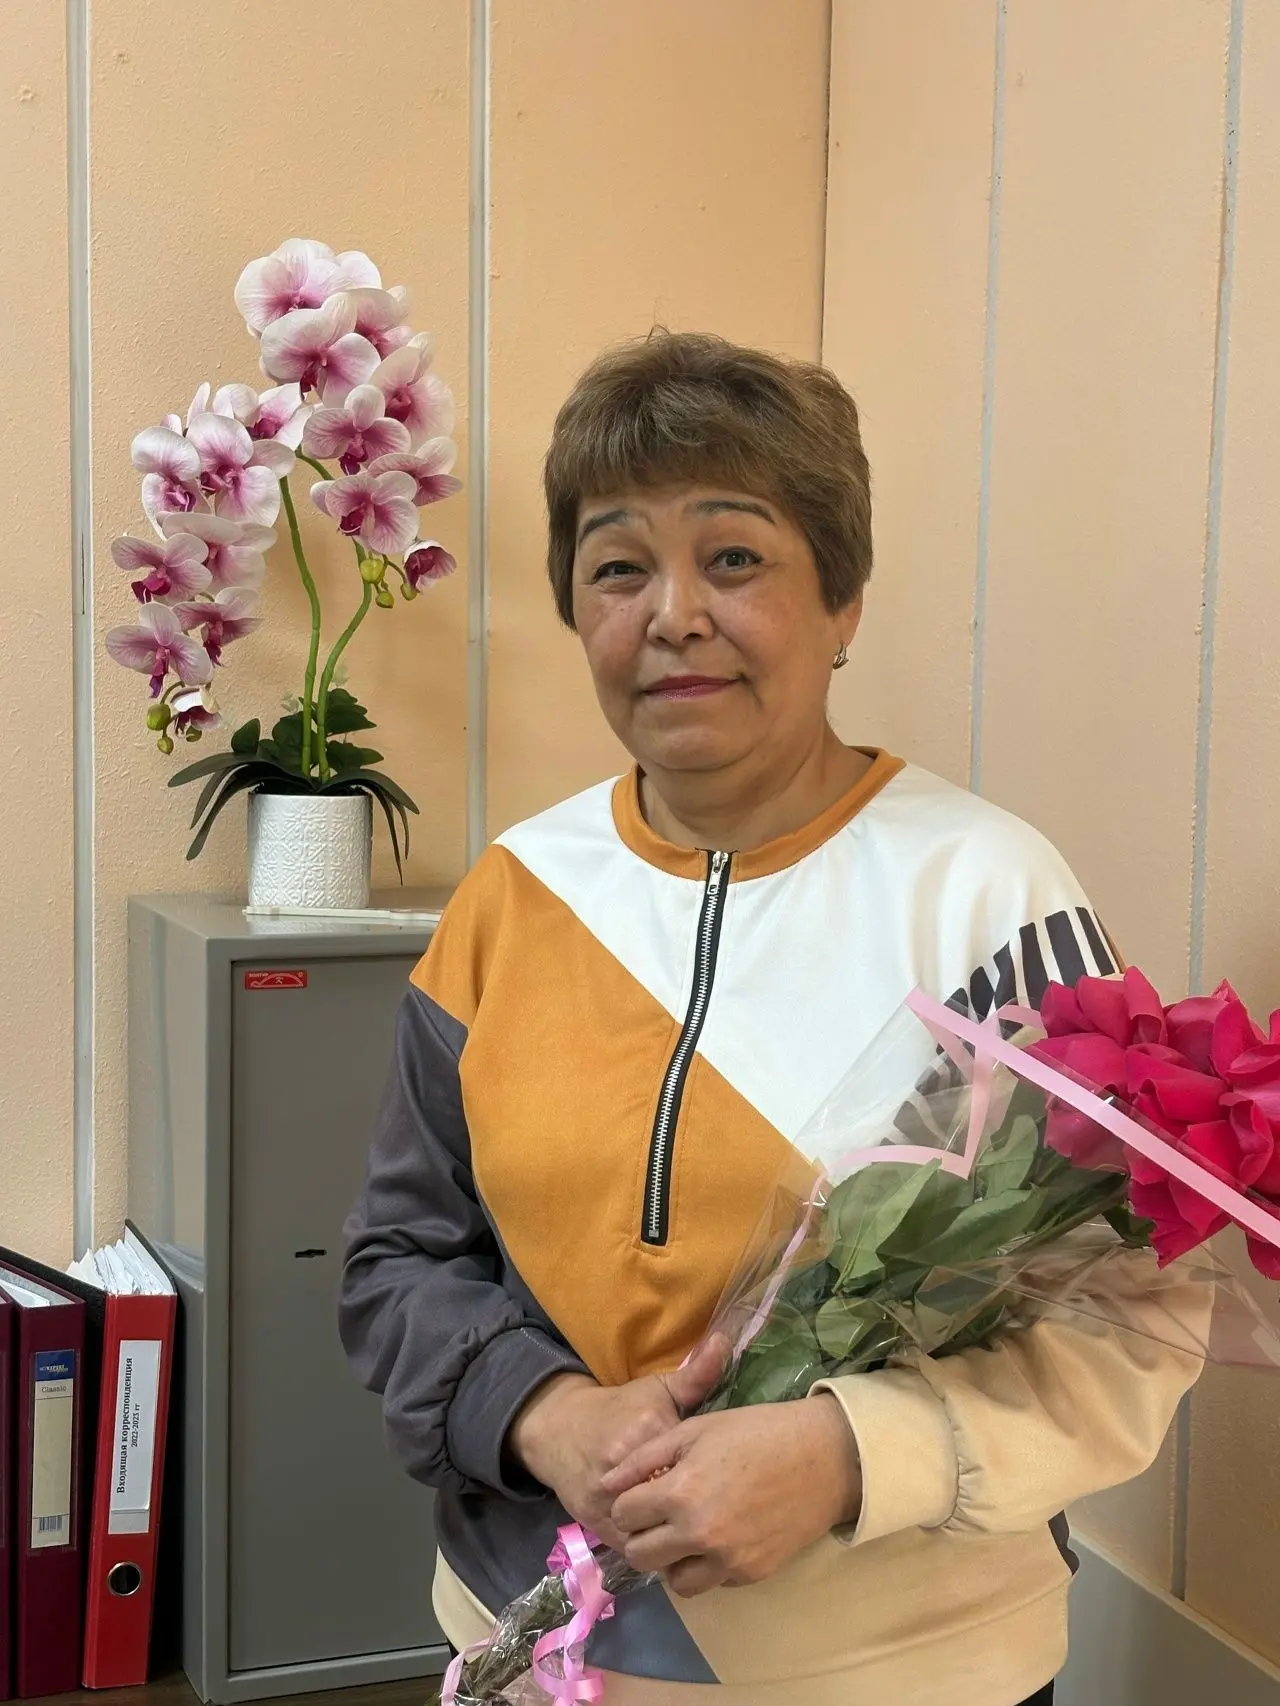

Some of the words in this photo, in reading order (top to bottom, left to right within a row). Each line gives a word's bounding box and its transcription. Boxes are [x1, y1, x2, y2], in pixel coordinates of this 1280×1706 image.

[116, 1444, 127, 1493] Входящая
[122, 1357, 133, 1442] корреспонденция
[131, 1412, 140, 1447] 2022-2023
